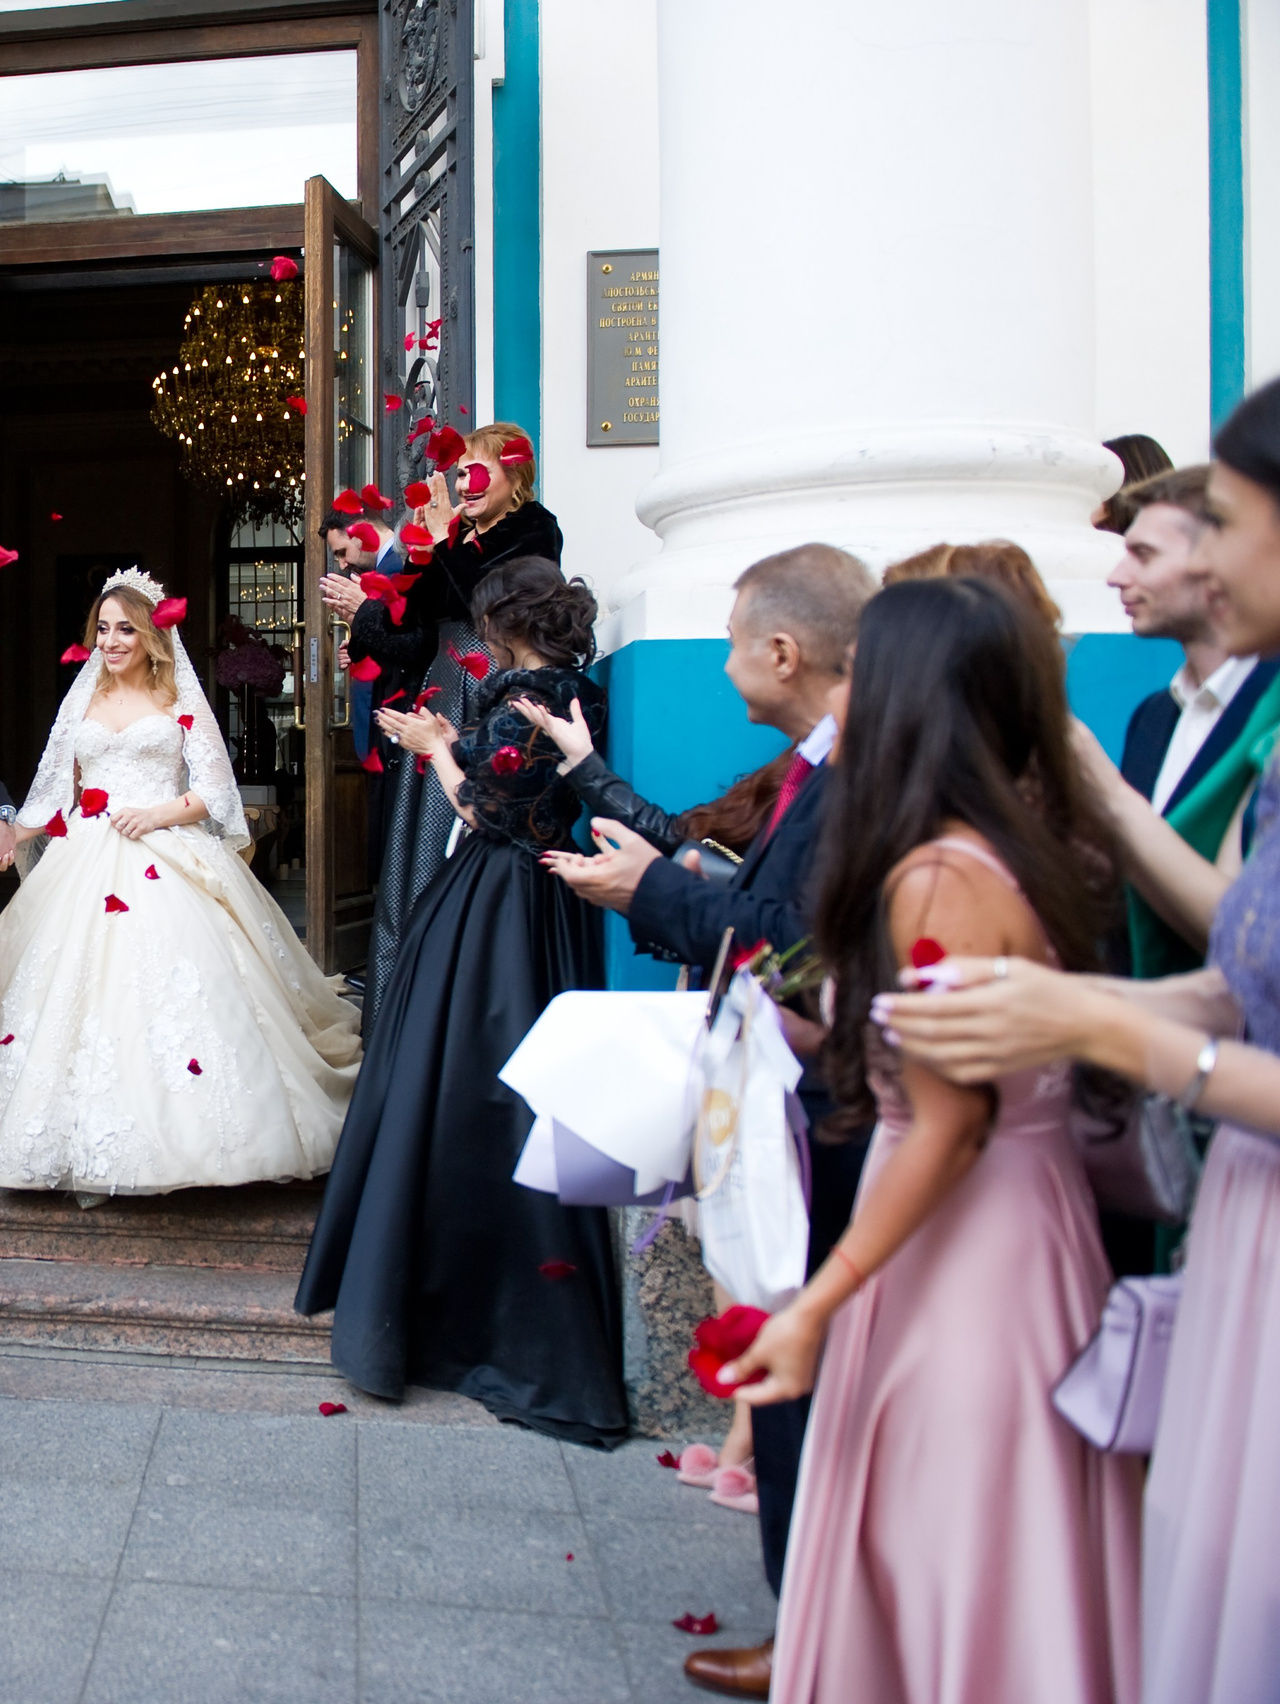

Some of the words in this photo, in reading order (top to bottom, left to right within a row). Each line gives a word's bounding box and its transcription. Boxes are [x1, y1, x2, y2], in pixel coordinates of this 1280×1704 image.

[611, 300, 643, 313] СВЯТОЙ
[599, 316, 648, 328] ПОСТРОЕНА
[651, 316, 657, 326] В
[625, 376, 659, 387] АРХИТЕ
